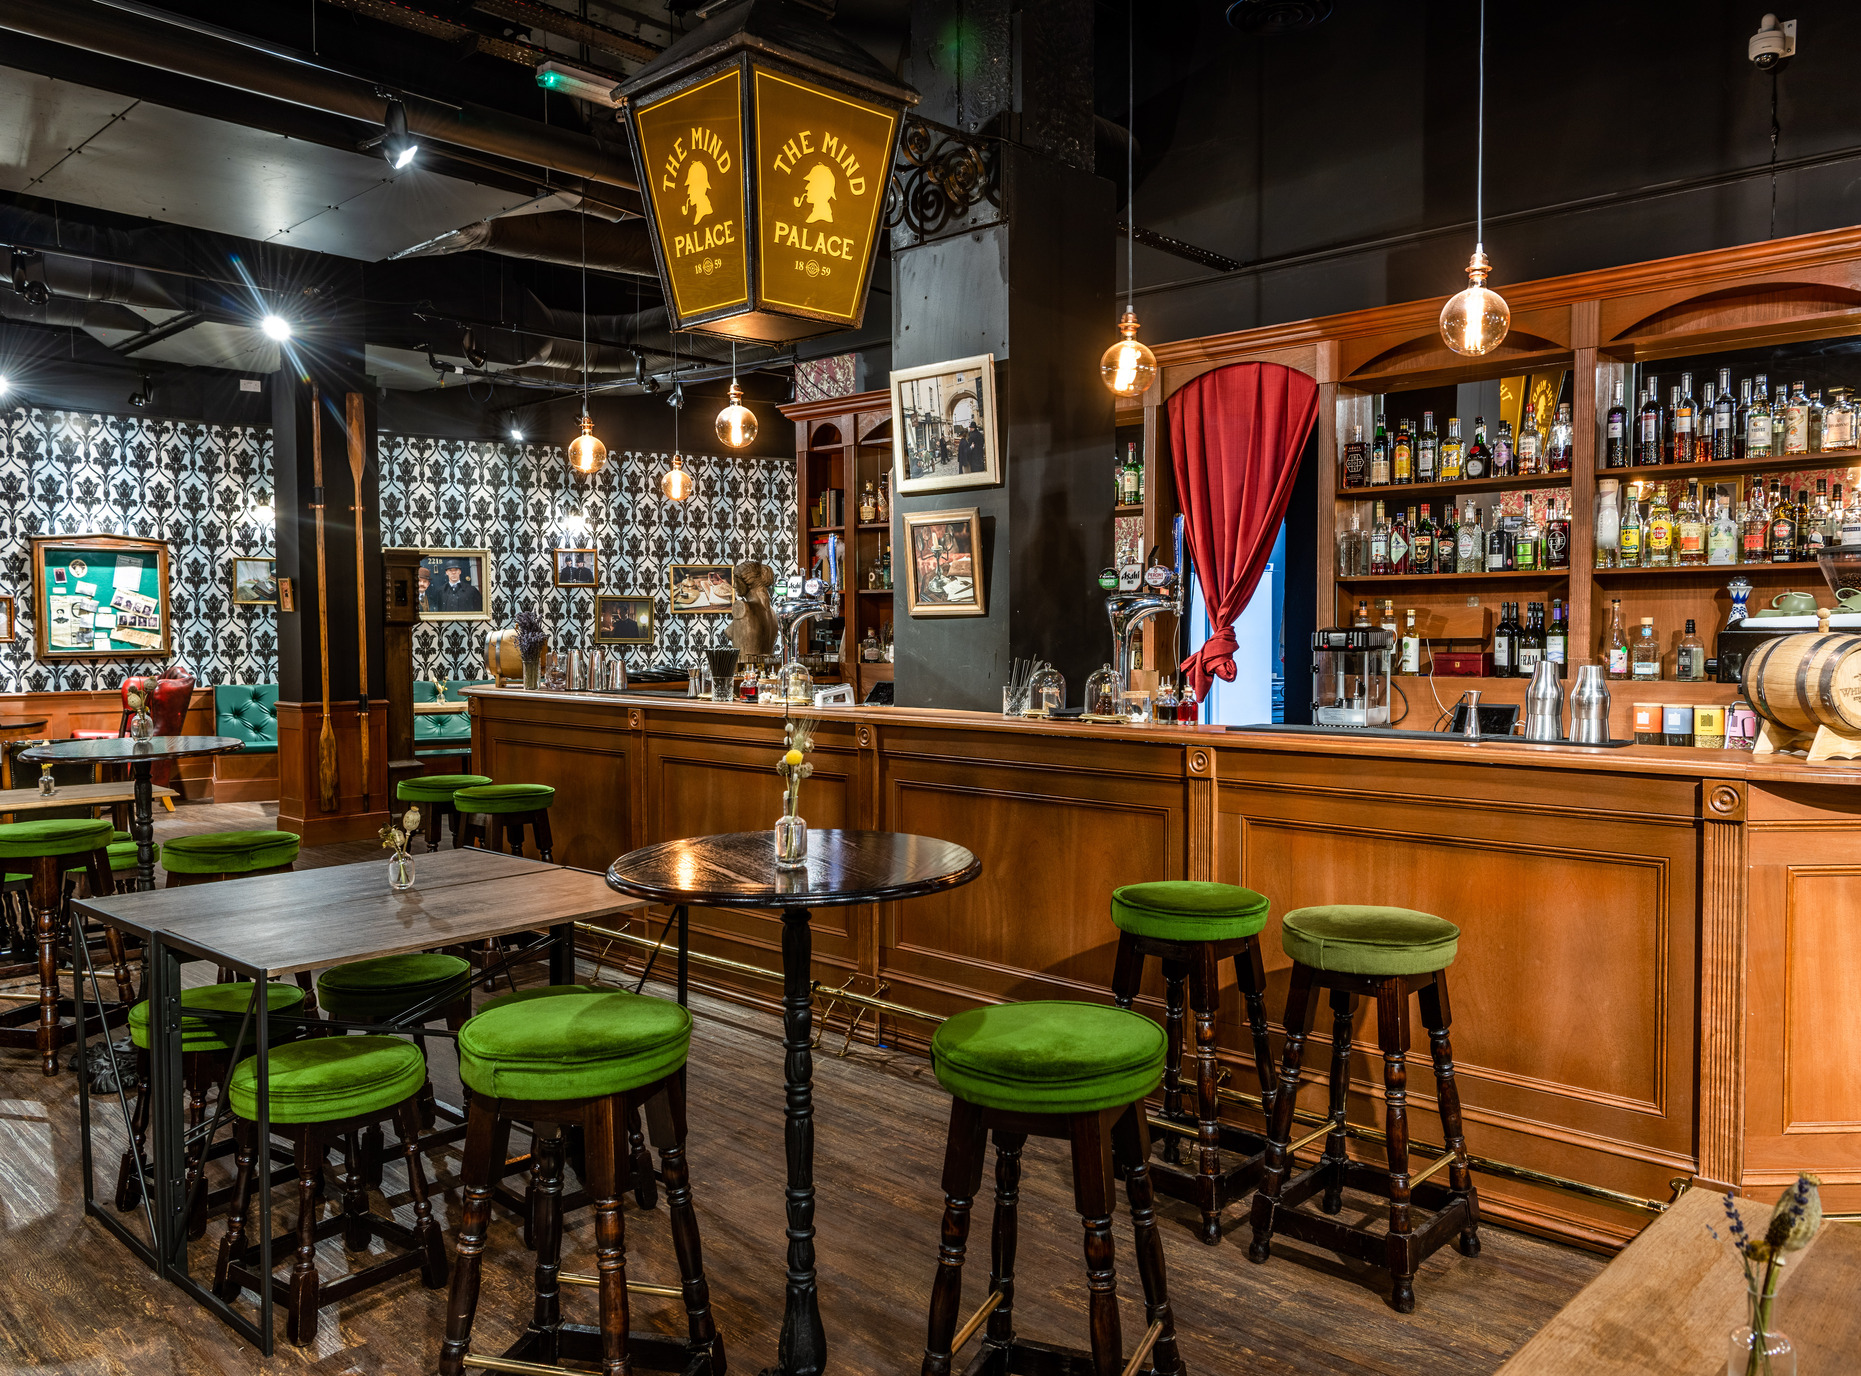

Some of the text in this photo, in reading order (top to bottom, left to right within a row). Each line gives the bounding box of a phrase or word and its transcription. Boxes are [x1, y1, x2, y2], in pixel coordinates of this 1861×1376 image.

[663, 127, 731, 193] THE MIND
[773, 130, 866, 196] THE MIND
[674, 220, 735, 258] PALACE
[773, 221, 855, 261] PALACE
[695, 259, 722, 274] 18 59
[794, 260, 831, 277] 18 59
[1121, 571, 1140, 580] Asahi
[1840, 687, 1861, 697] WHI
